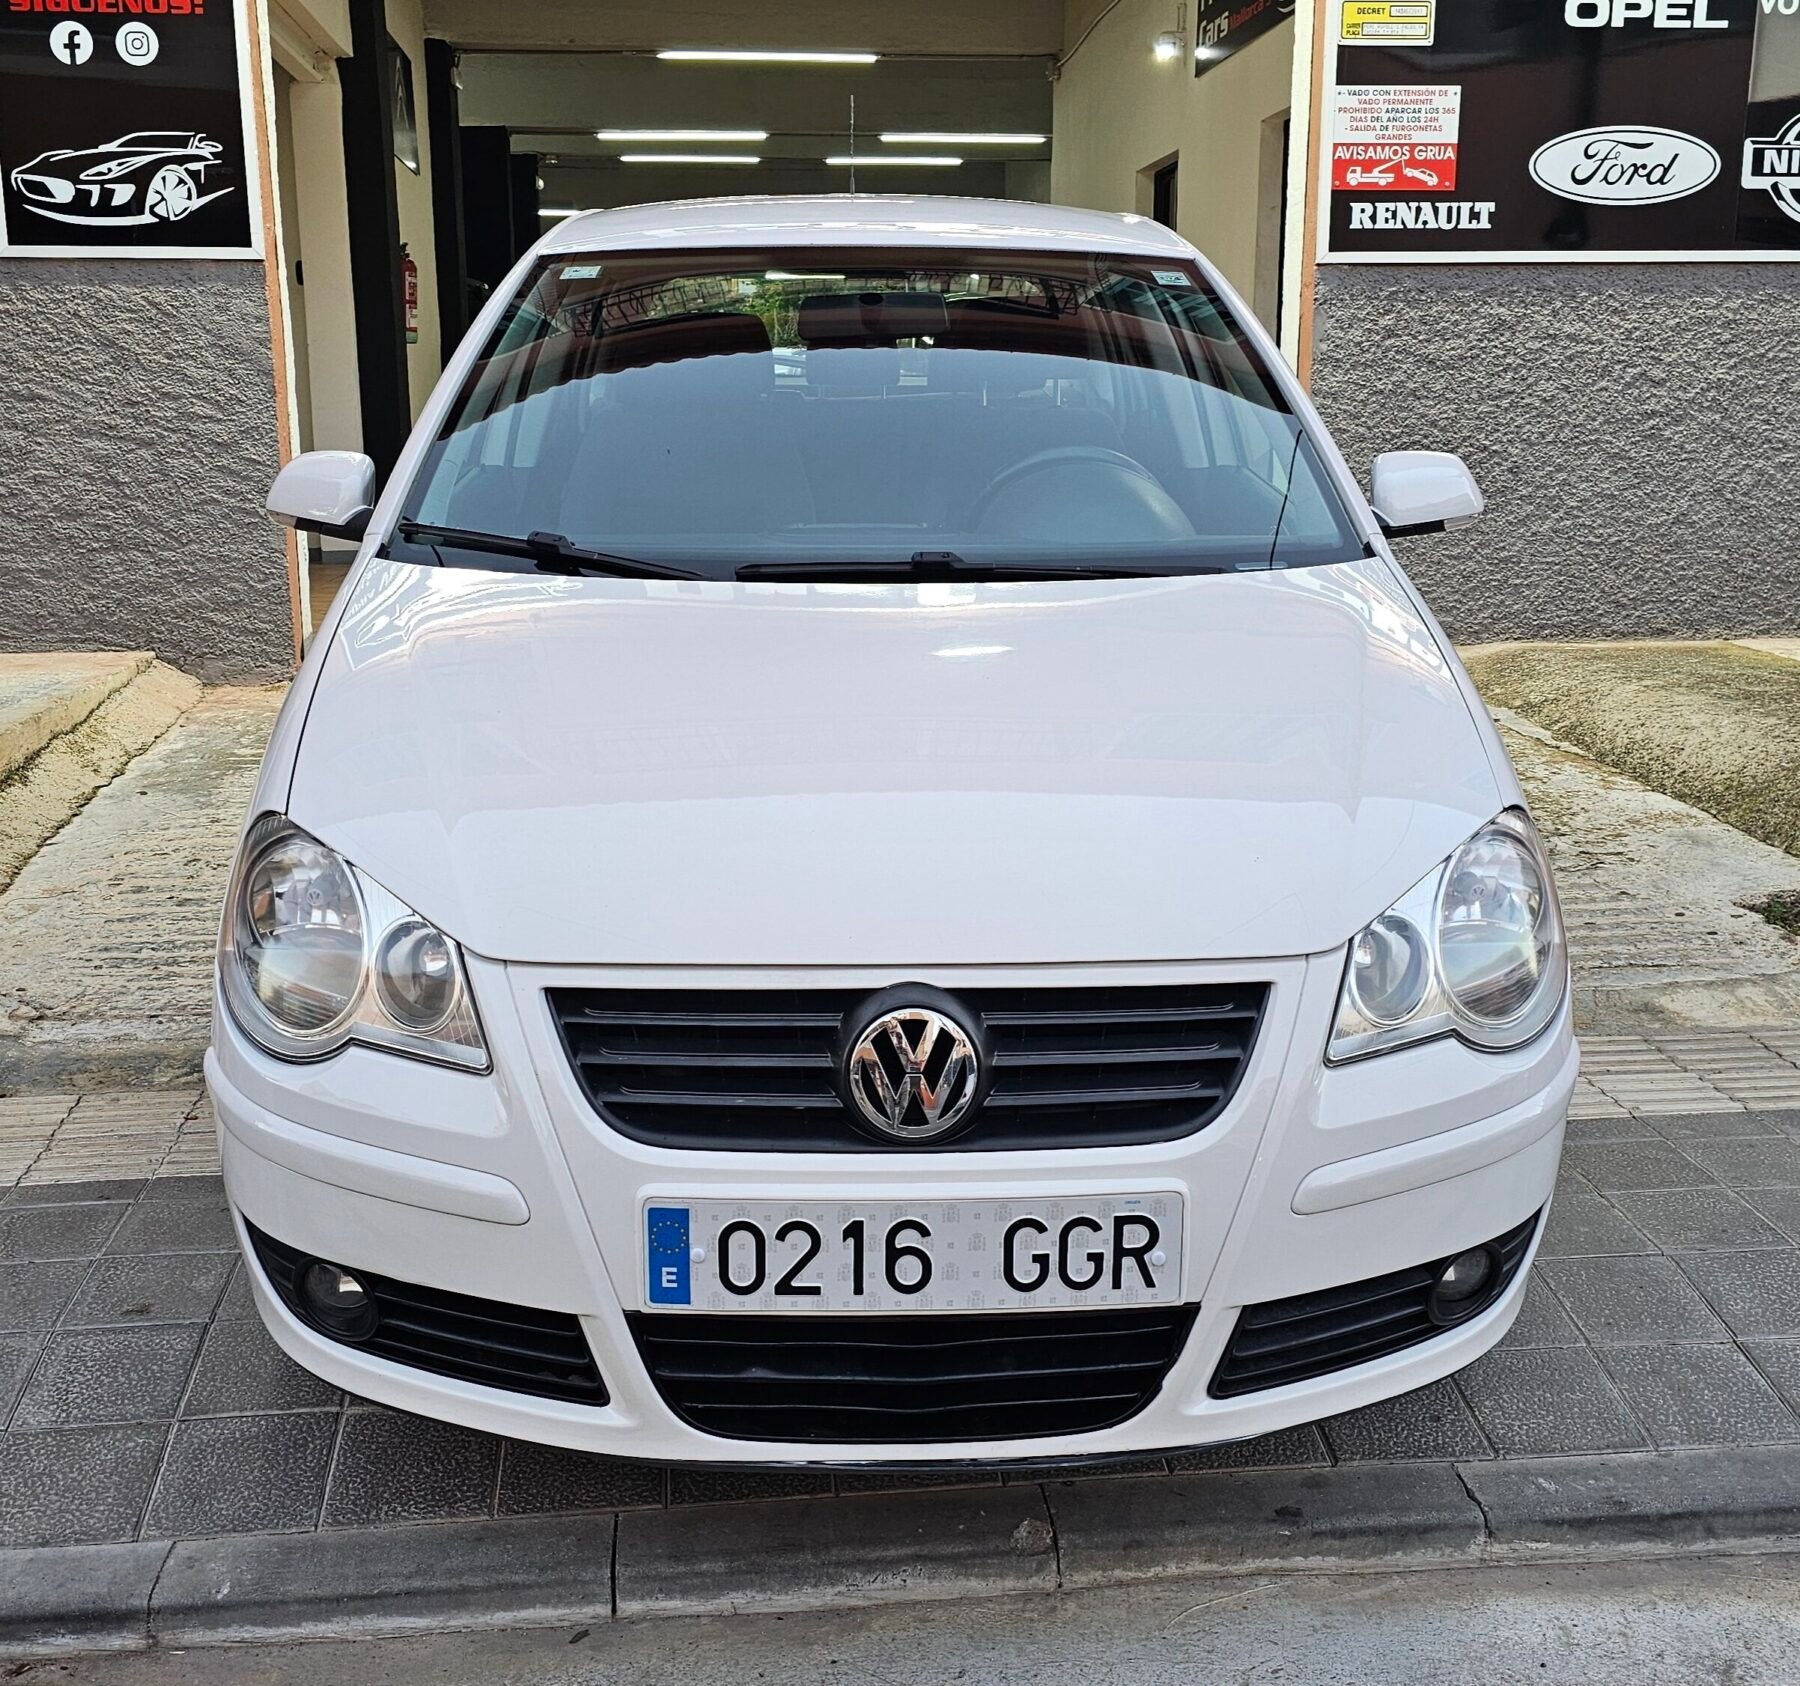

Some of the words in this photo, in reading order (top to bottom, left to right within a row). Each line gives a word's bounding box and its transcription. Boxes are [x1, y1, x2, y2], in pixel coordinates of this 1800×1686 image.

[1356, 7, 1386, 15] DECRET
[1564, 0, 1729, 28] OPEL
[1347, 89, 1370, 97] VADO
[1372, 89, 1391, 97] CON
[1393, 88, 1436, 97] EXTENSIÓN
[1438, 89, 1449, 97] DE
[1357, 98, 1381, 106] VADO
[1382, 98, 1434, 106] PERMANENTE
[1374, 133, 1413, 141] GRANDES
[1334, 145, 1411, 160] AVISAMOS
[1414, 146, 1455, 160] GRUA
[1570, 139, 1680, 186] Ford
[1349, 202, 1495, 230] RENAULT
[717, 1218, 933, 1296] 0216
[1002, 1213, 1161, 1293] GGR
[660, 1266, 679, 1288] E
